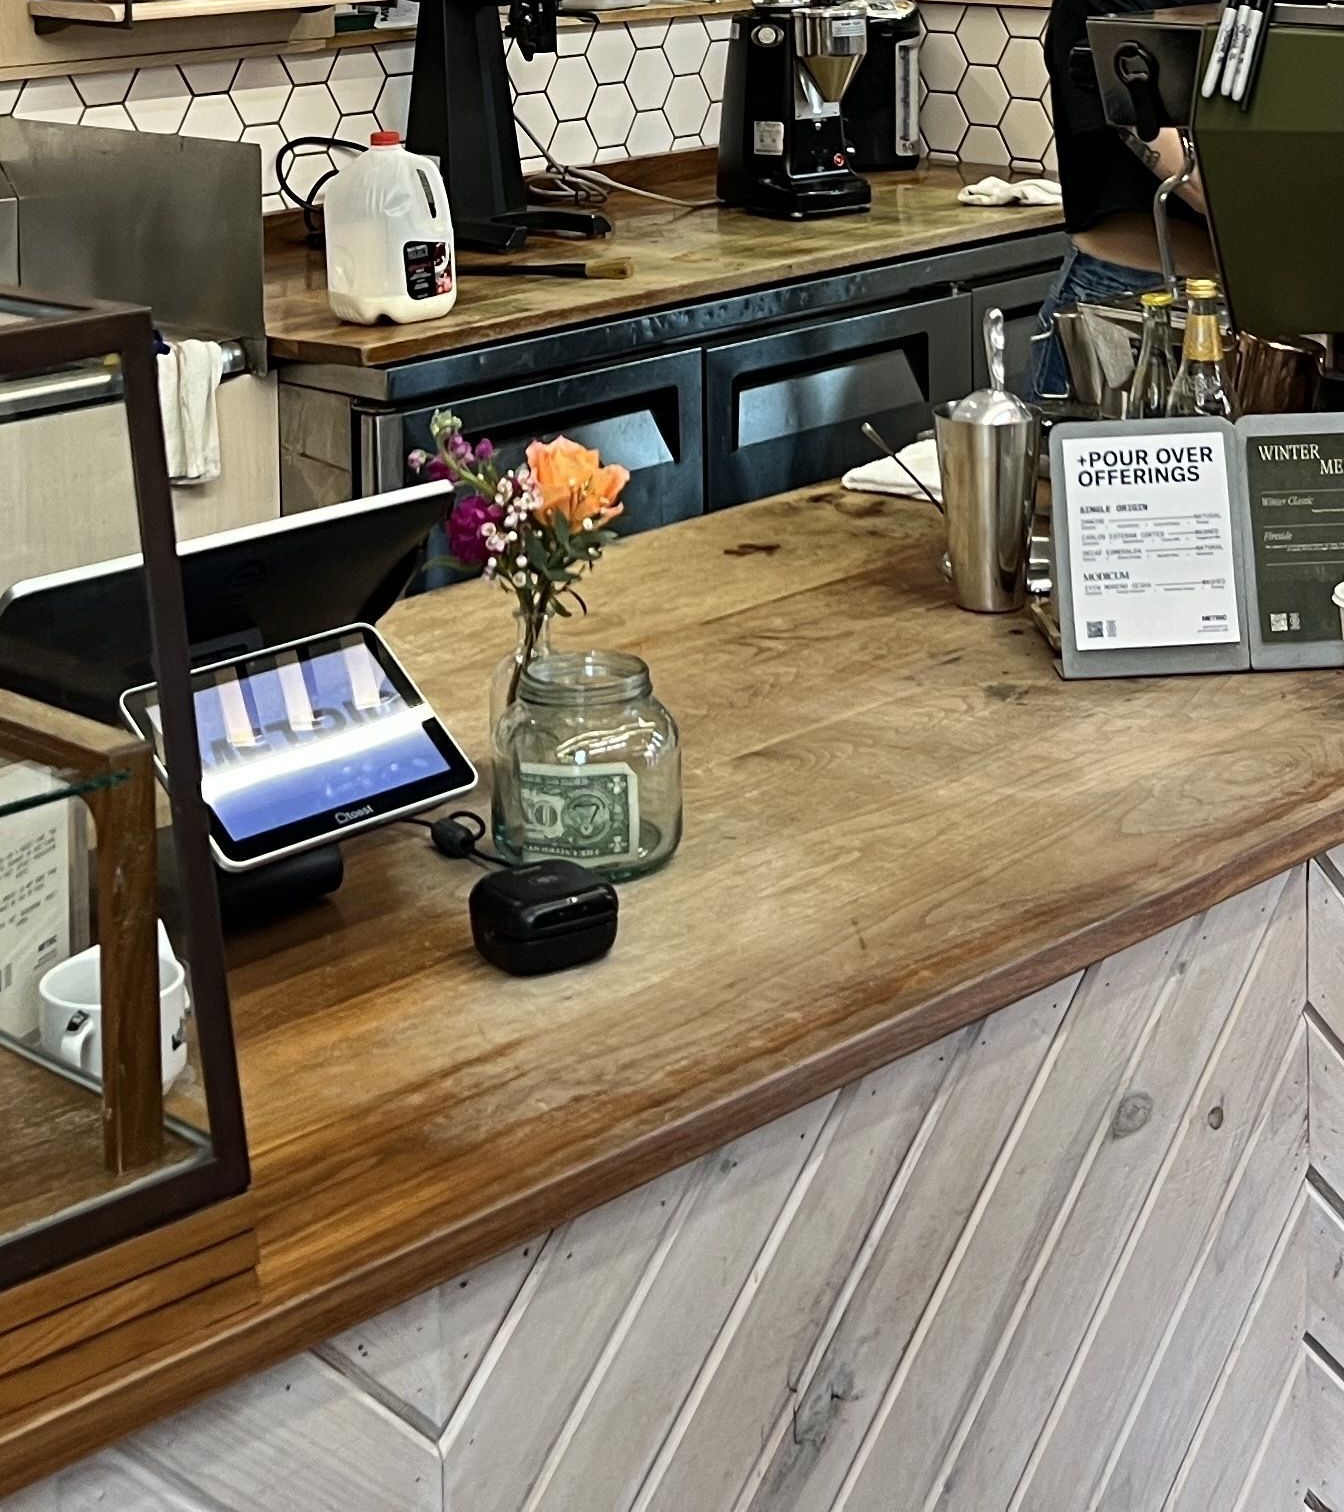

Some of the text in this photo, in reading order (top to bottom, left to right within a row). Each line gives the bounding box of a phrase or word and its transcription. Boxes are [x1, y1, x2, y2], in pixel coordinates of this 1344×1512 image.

[1077, 446, 1213, 468] +POUR OVER
[1258, 443, 1321, 462] WINTER
[1078, 465, 1200, 487] OFFERINGS
